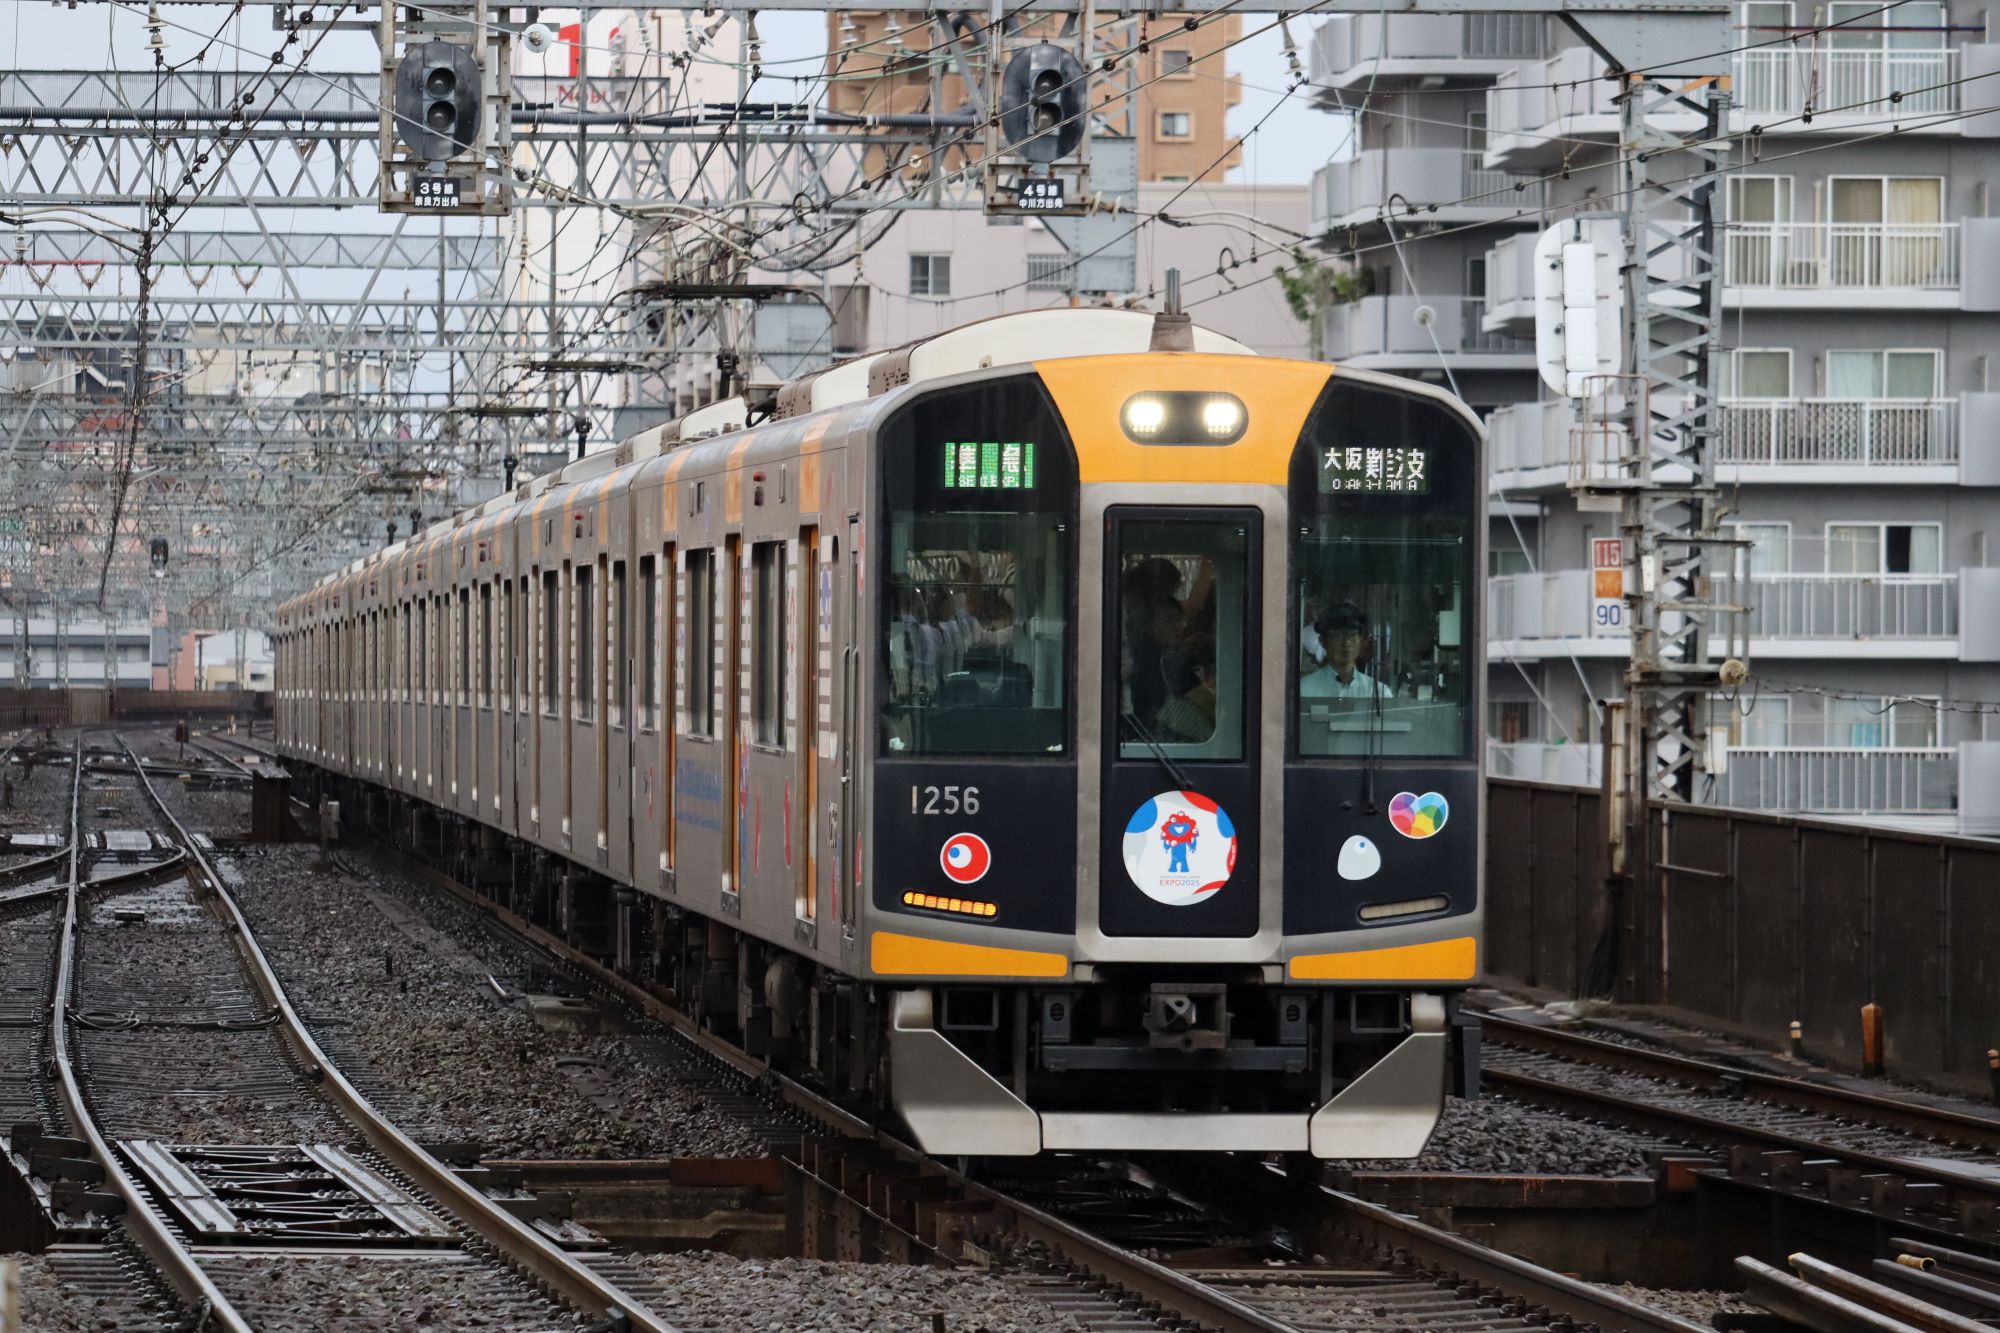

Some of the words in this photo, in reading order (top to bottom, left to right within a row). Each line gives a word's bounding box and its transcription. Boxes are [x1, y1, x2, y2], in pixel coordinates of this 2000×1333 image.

[414, 196, 459, 207] 奈良方出発
[1324, 447, 1425, 480] 大阪難波
[1595, 542, 1621, 568] 115
[1597, 604, 1621, 626] 90
[911, 785, 980, 815] 1256
